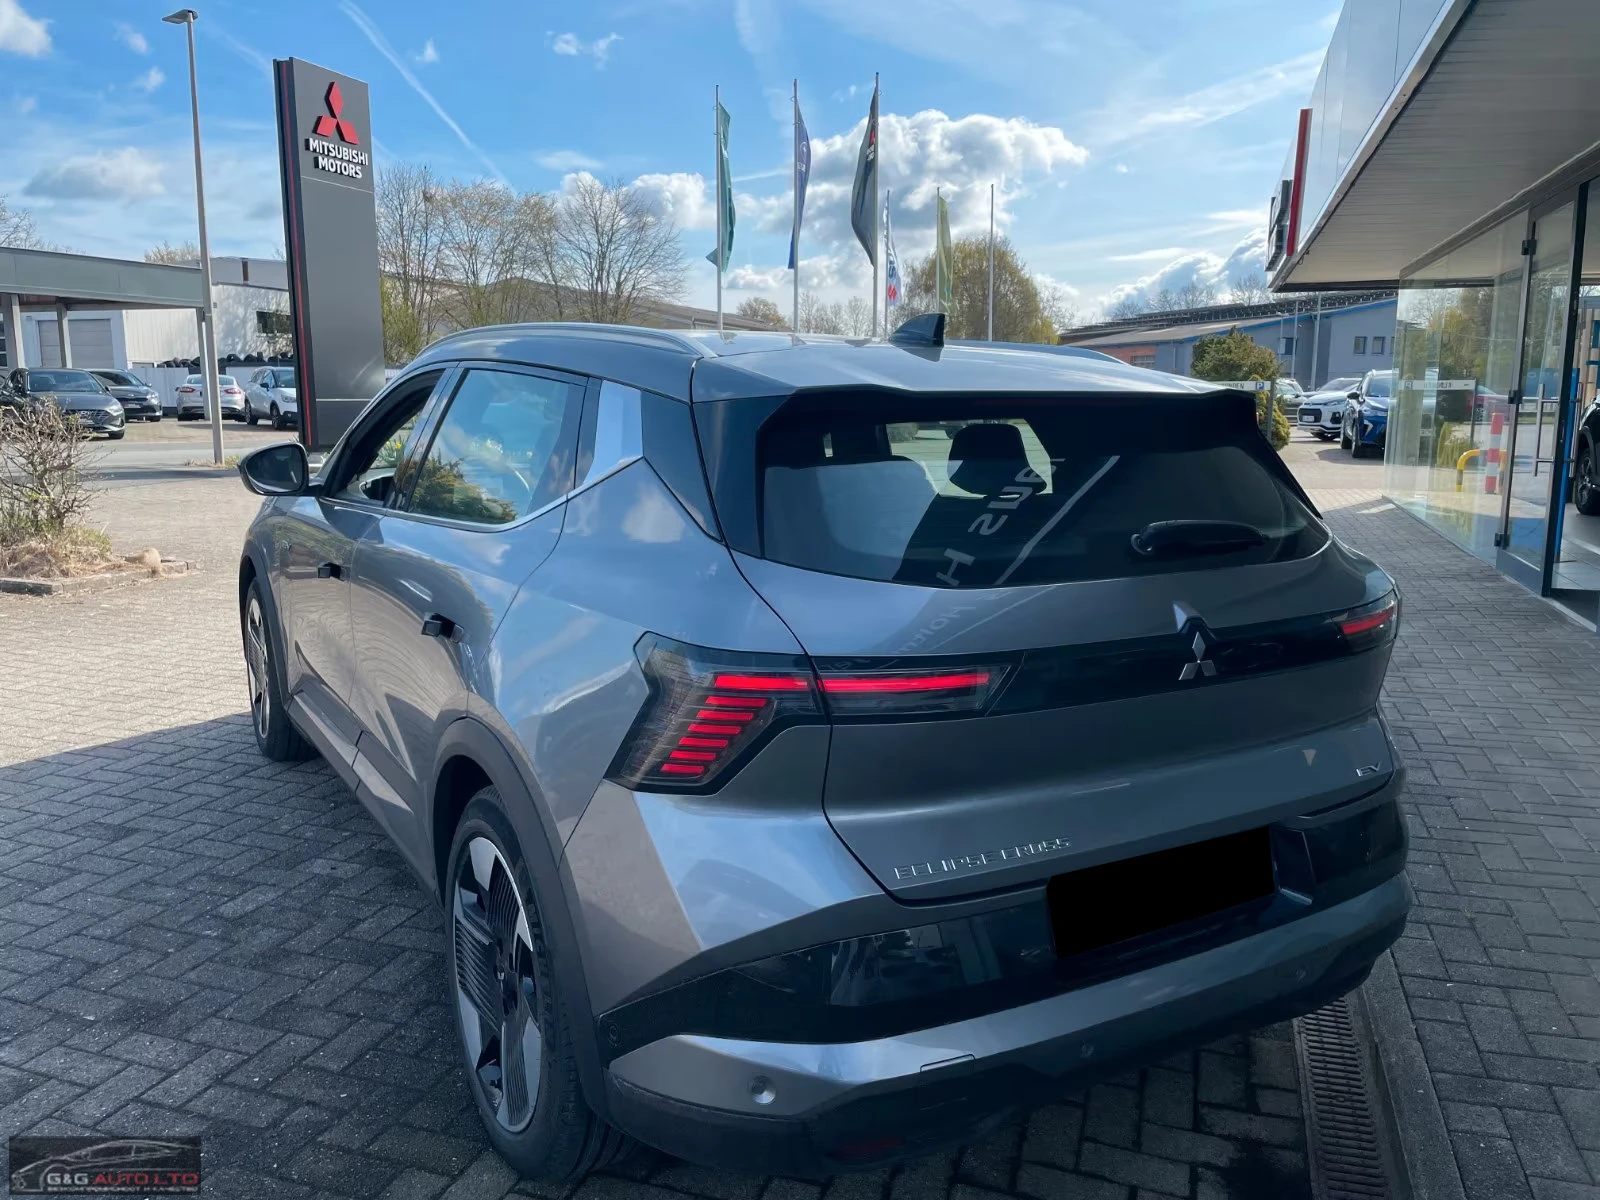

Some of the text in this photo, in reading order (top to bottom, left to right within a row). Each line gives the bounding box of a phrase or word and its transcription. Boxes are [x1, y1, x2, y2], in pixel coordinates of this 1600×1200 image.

[308, 137, 369, 166] MITSUBISHI
[318, 155, 363, 179] MOTORS
[1356, 760, 1383, 777] EV
[893, 837, 1073, 881] ECLIPSE CROSS
